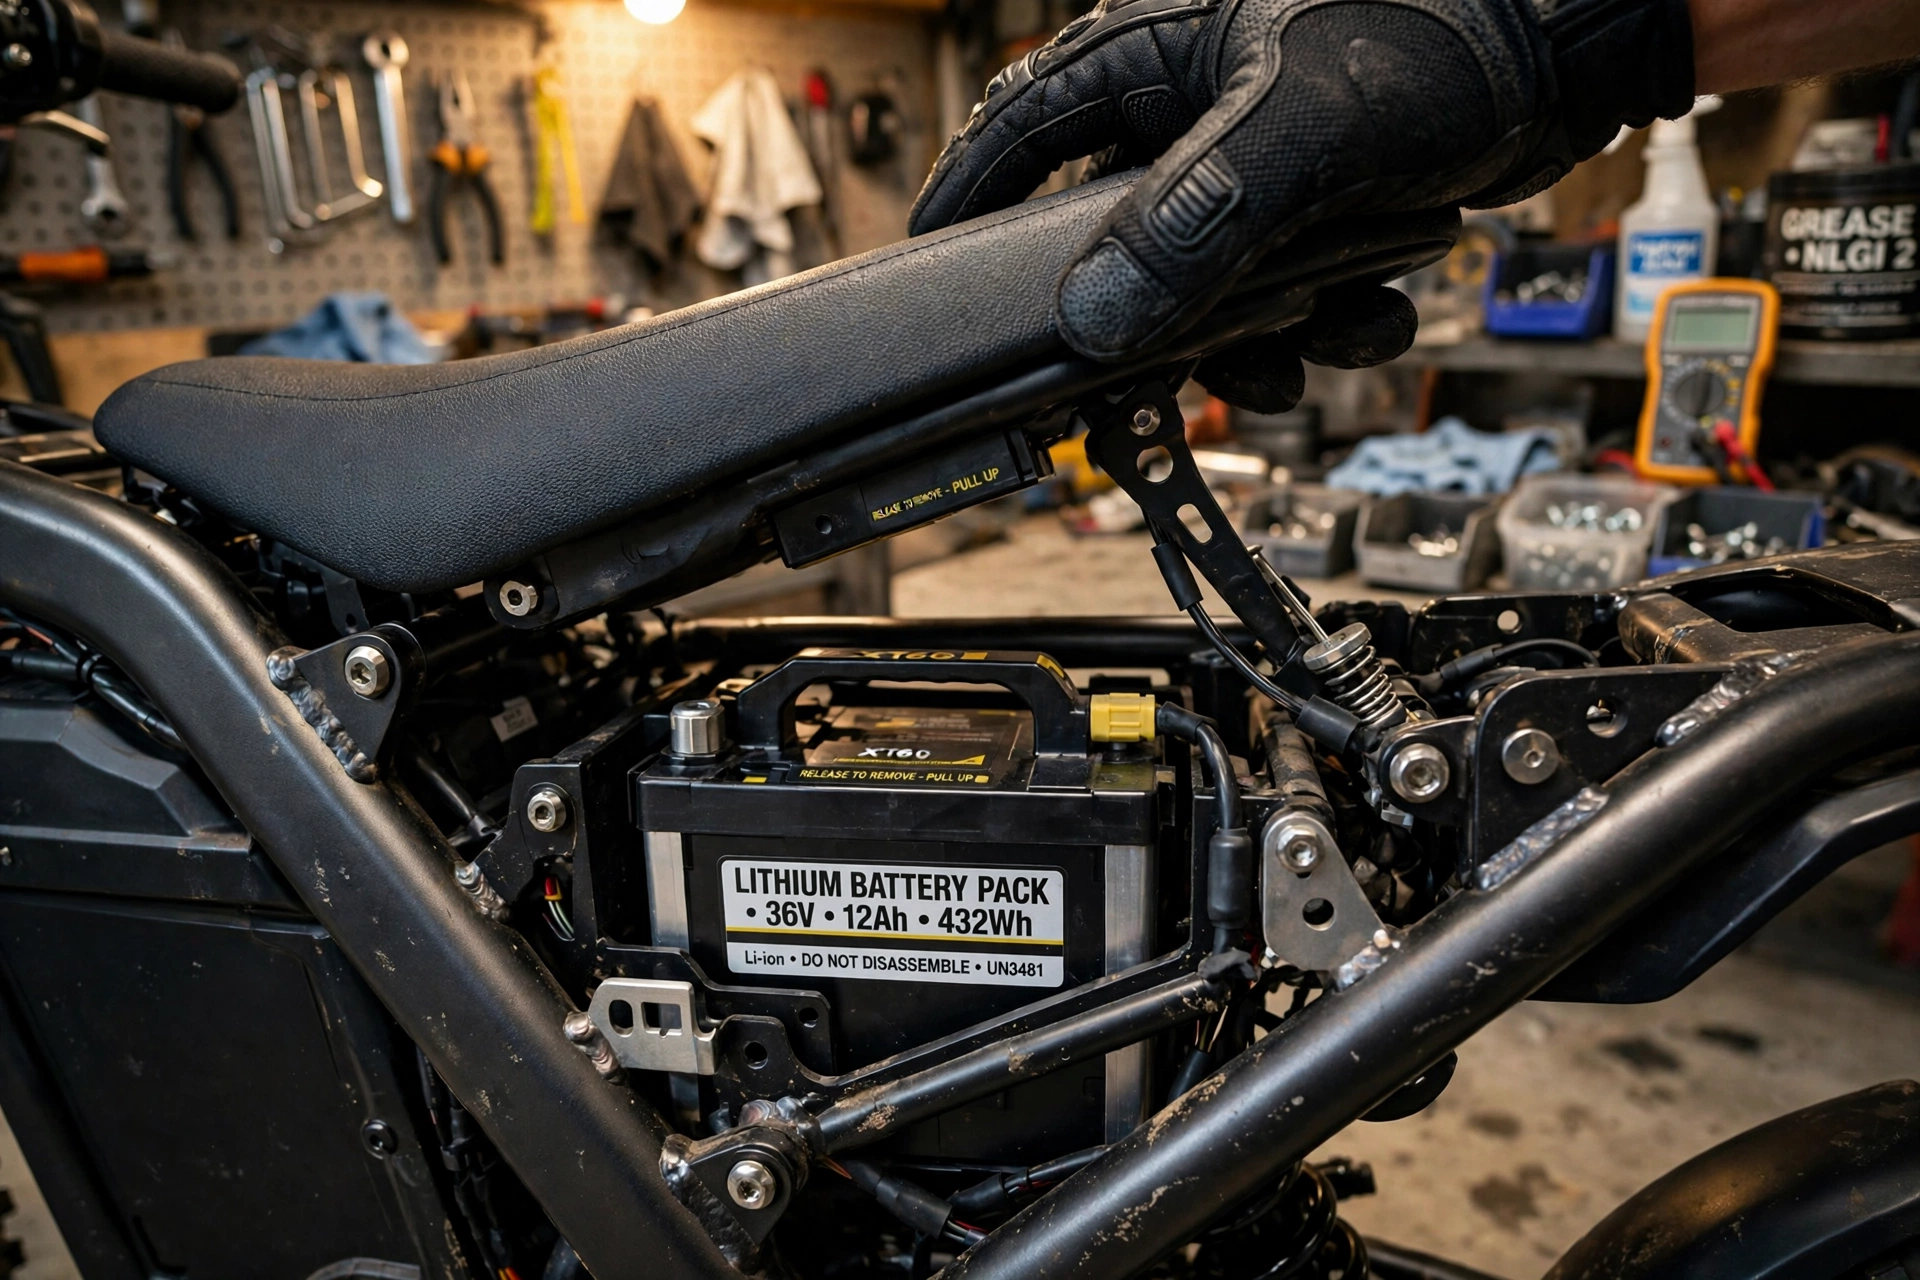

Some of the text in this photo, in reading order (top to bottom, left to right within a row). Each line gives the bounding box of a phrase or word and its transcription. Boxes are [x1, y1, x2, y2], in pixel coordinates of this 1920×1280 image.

[1781, 204, 1916, 240] GREASE
[1892, 238, 1917, 270] 2
[952, 474, 982, 493] PULL
[983, 467, 999, 482] UP
[799, 769, 849, 779] RELEASE
[852, 770, 867, 780] TO
[869, 771, 916, 781] REMOVE
[926, 773, 953, 782] PULL
[957, 774, 974, 782] UP
[735, 867, 1050, 905] LITHIUM BATTERY PACK
[765, 900, 815, 928] 36V
[843, 904, 908, 932] 12Ah
[938, 907, 1032, 937] 432Wh
[745, 950, 785, 966] Li-ion
[802, 953, 823, 967] DO
[828, 953, 858, 969] NOT
[863, 955, 970, 975] DISASSEMBLE
[987, 960, 1043, 977] UN3481
